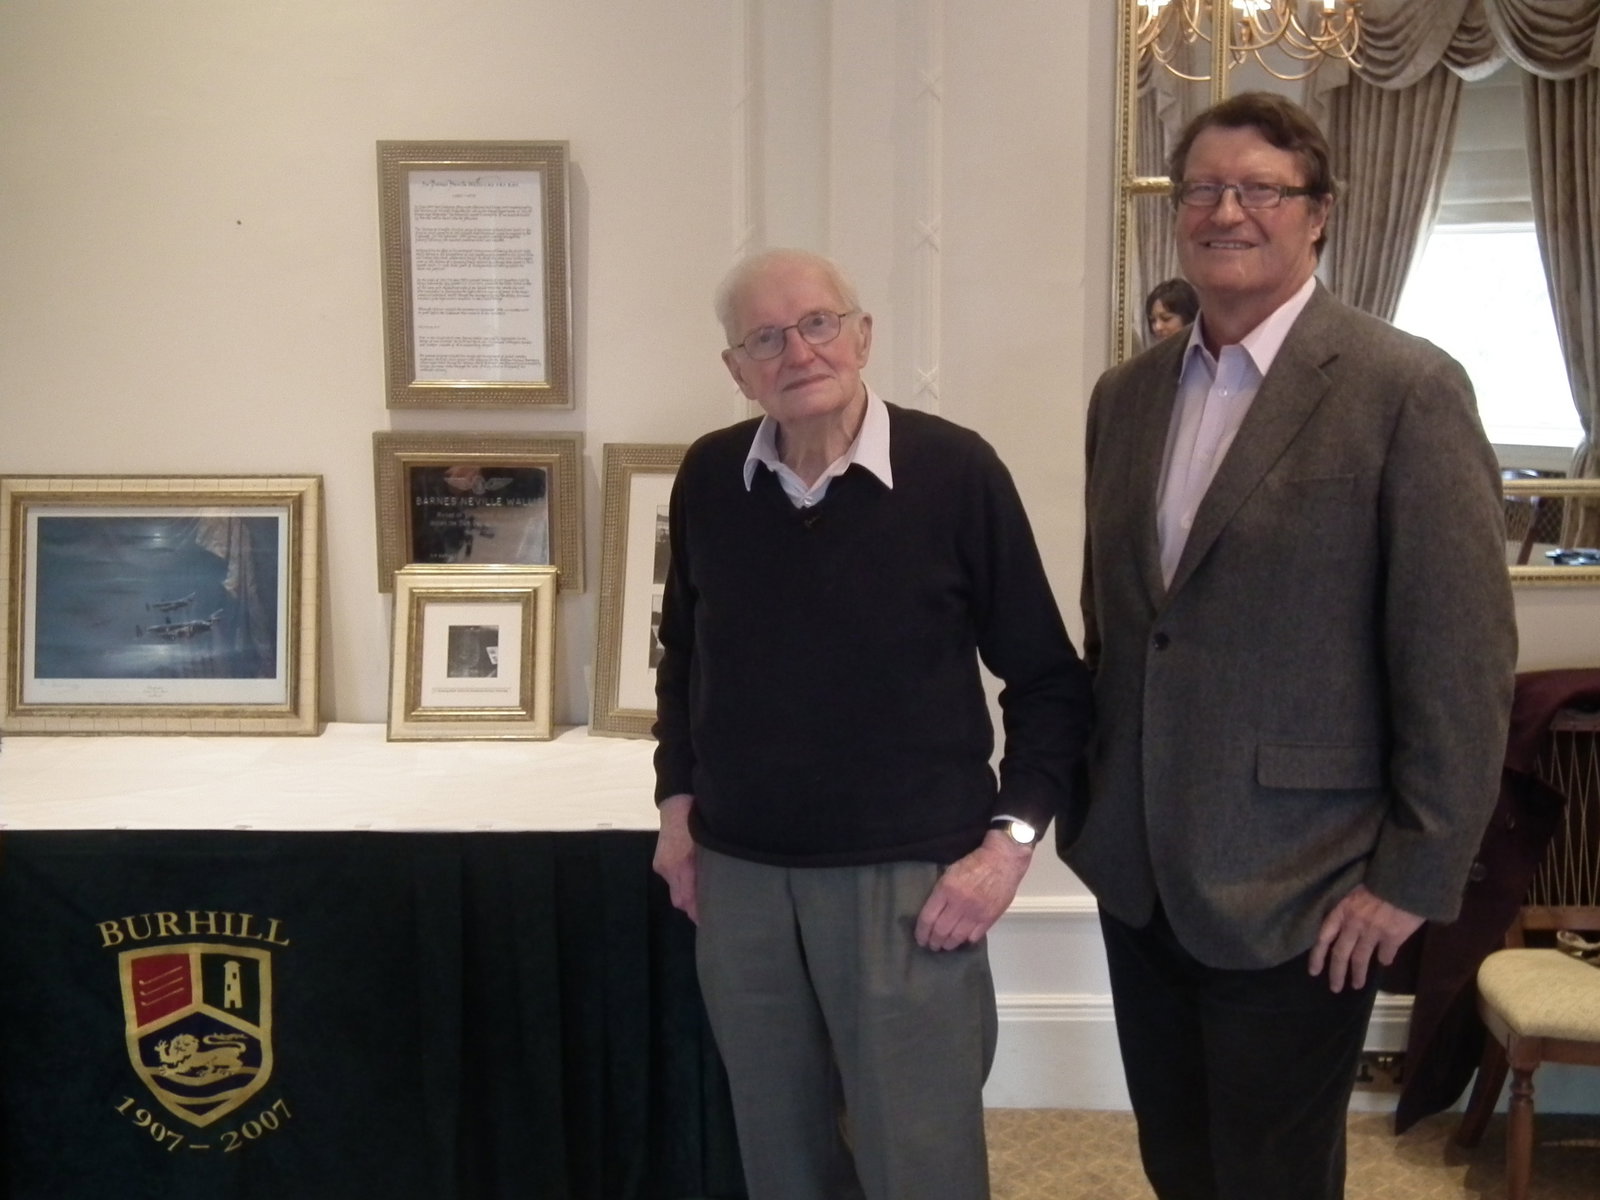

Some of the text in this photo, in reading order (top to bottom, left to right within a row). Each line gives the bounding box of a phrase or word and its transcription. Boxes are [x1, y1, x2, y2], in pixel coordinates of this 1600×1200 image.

[415, 496, 543, 506] BARNES NEVILLE WALL
[95, 910, 290, 948] BURHILL
[114, 1095, 184, 1152] 1907
[220, 1098, 292, 1152] 2007
